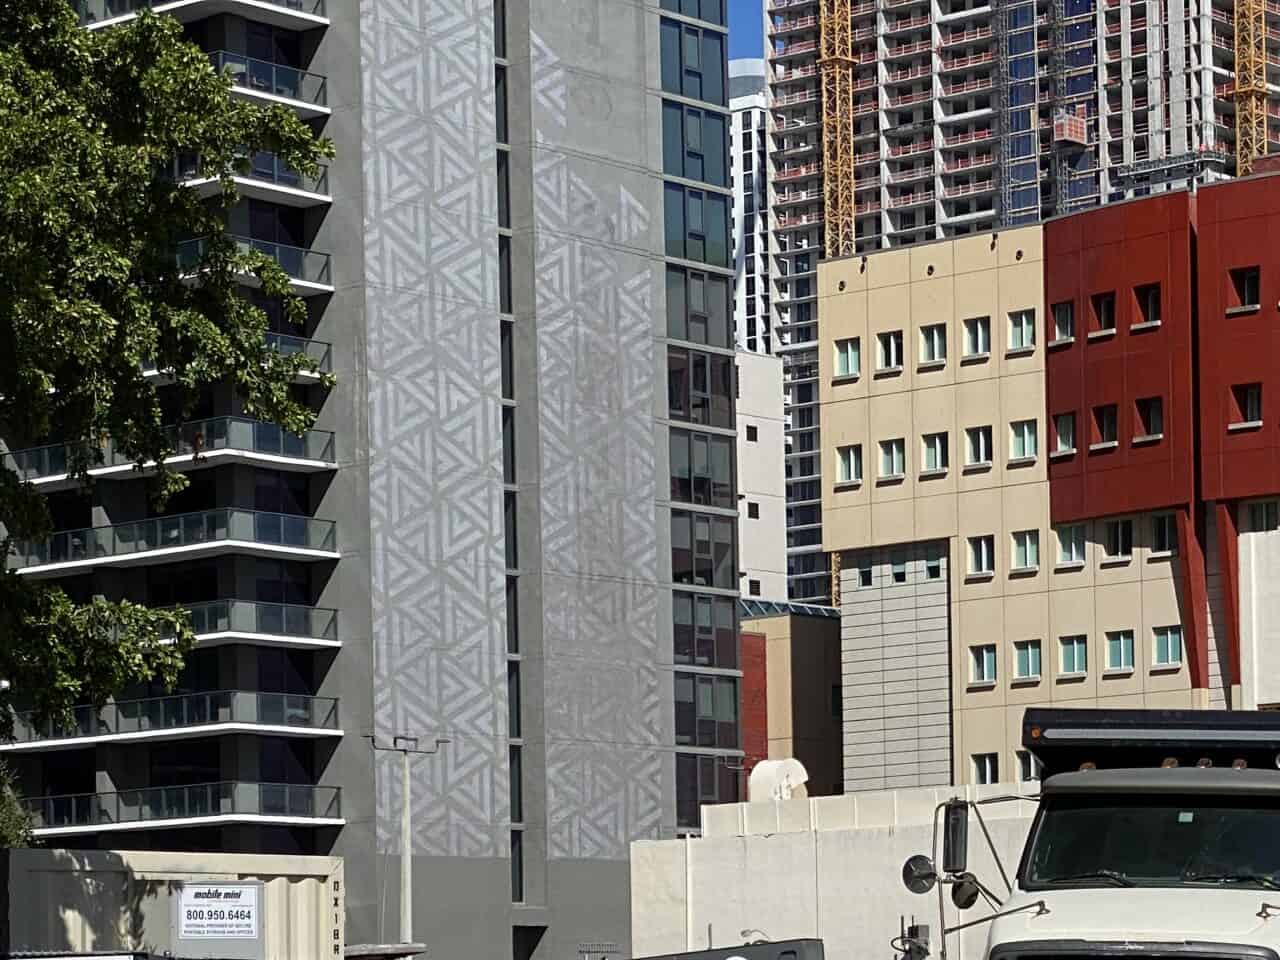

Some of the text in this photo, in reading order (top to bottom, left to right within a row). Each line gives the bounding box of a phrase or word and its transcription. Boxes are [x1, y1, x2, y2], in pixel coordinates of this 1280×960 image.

[193, 888, 242, 899] mobile mini
[186, 909, 252, 921] 800.950.6464
